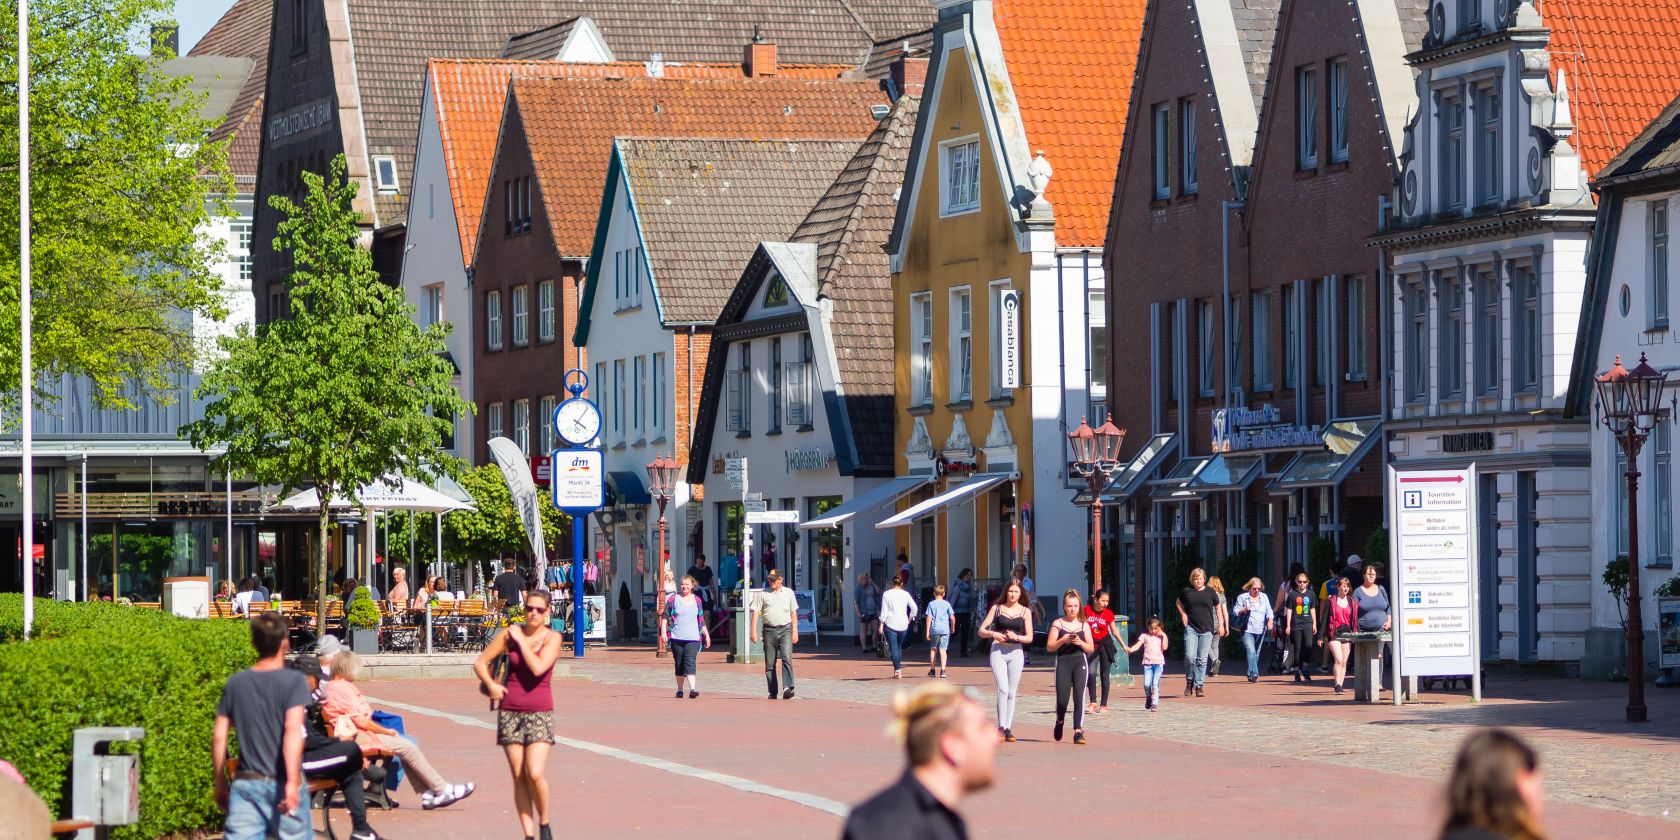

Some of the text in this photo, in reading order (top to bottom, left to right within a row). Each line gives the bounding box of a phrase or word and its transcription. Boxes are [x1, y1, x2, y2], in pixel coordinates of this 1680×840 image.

[319, 103, 332, 125] BANK
[572, 456, 588, 467] dm
[1427, 498, 1462, 506] Information
